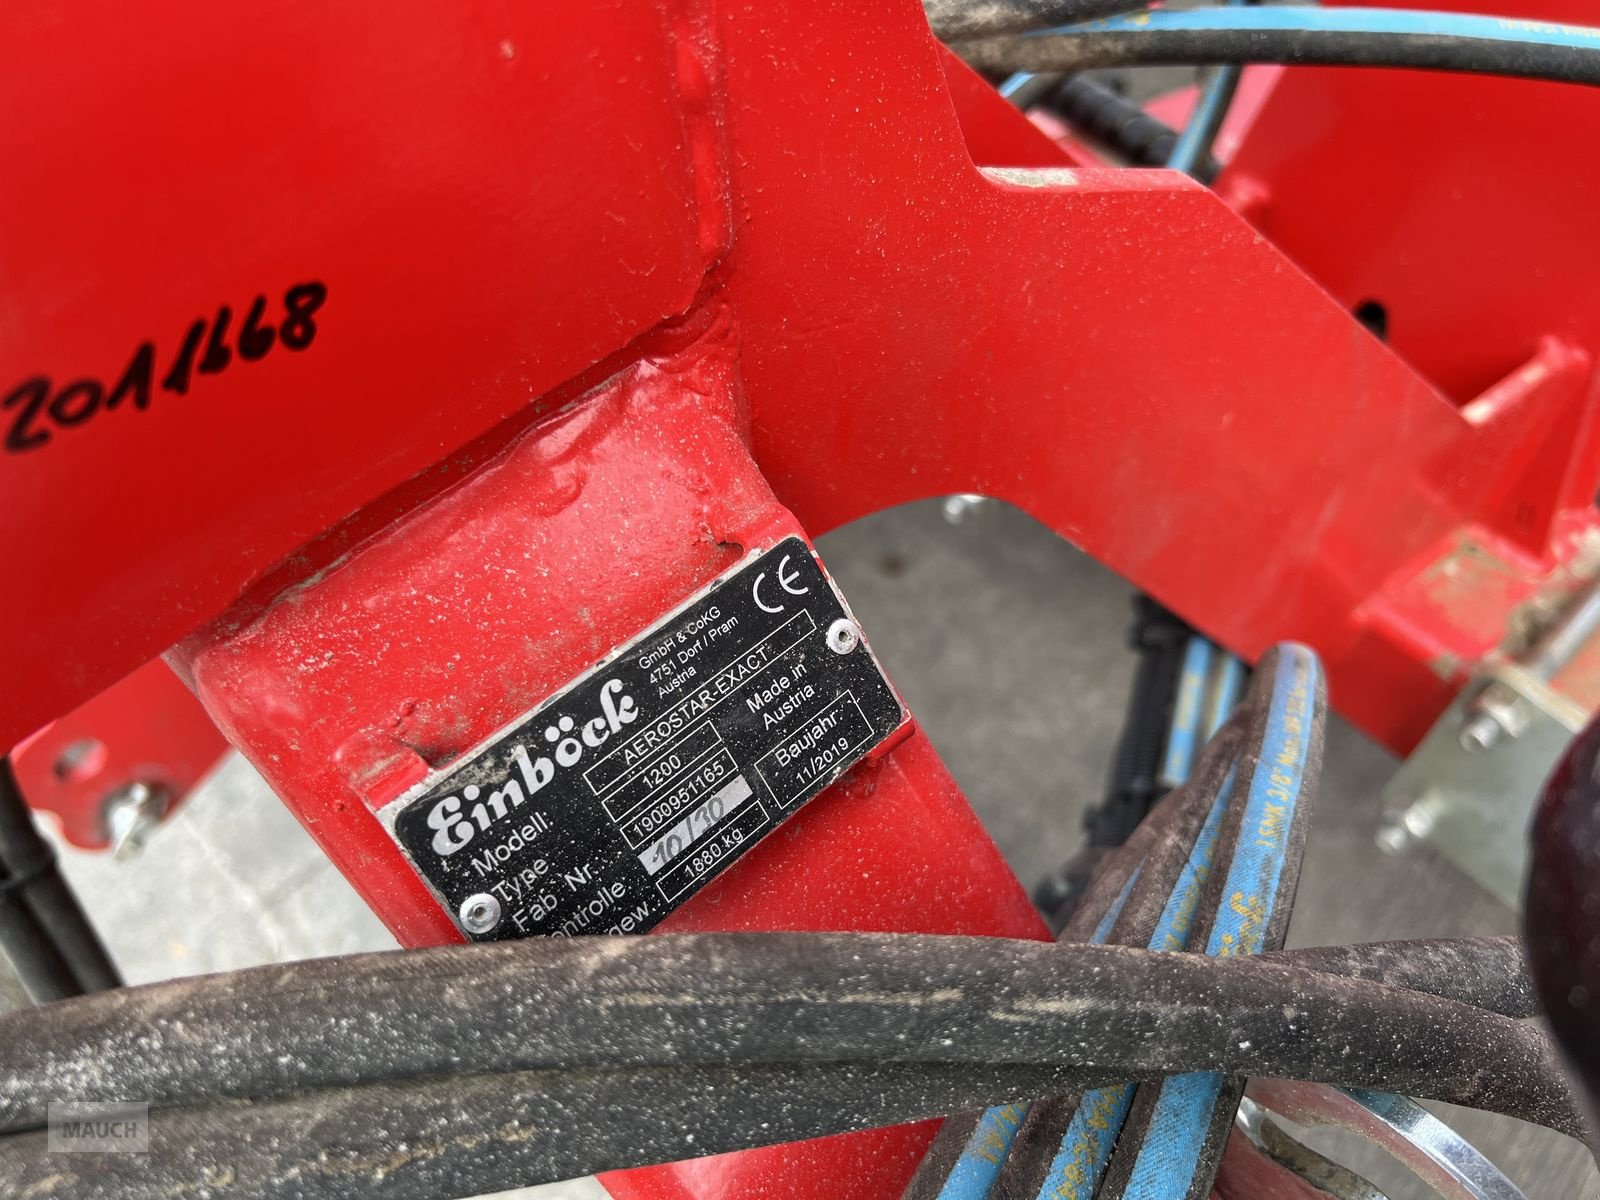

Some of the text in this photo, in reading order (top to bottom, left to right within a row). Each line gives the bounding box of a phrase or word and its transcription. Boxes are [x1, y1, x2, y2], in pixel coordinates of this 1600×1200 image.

[640, 606, 721, 669] GmbH & CoKG
[650, 615, 738, 684] 4751 Dorf / Pram
[658, 666, 696, 699] Austria
[745, 662, 807, 713] Made in
[762, 684, 815, 731] Austria
[472, 646, 770, 876] Modell: AEROSTAR-EXACT
[773, 710, 842, 767] Baujahr:
[796, 738, 848, 784] 11/2019
[427, 679, 640, 857] Einböck
[642, 755, 678, 789] 1200
[632, 759, 724, 836] 1900951165
[683, 843, 721, 877] 1880
[721, 828, 743, 850] kg
